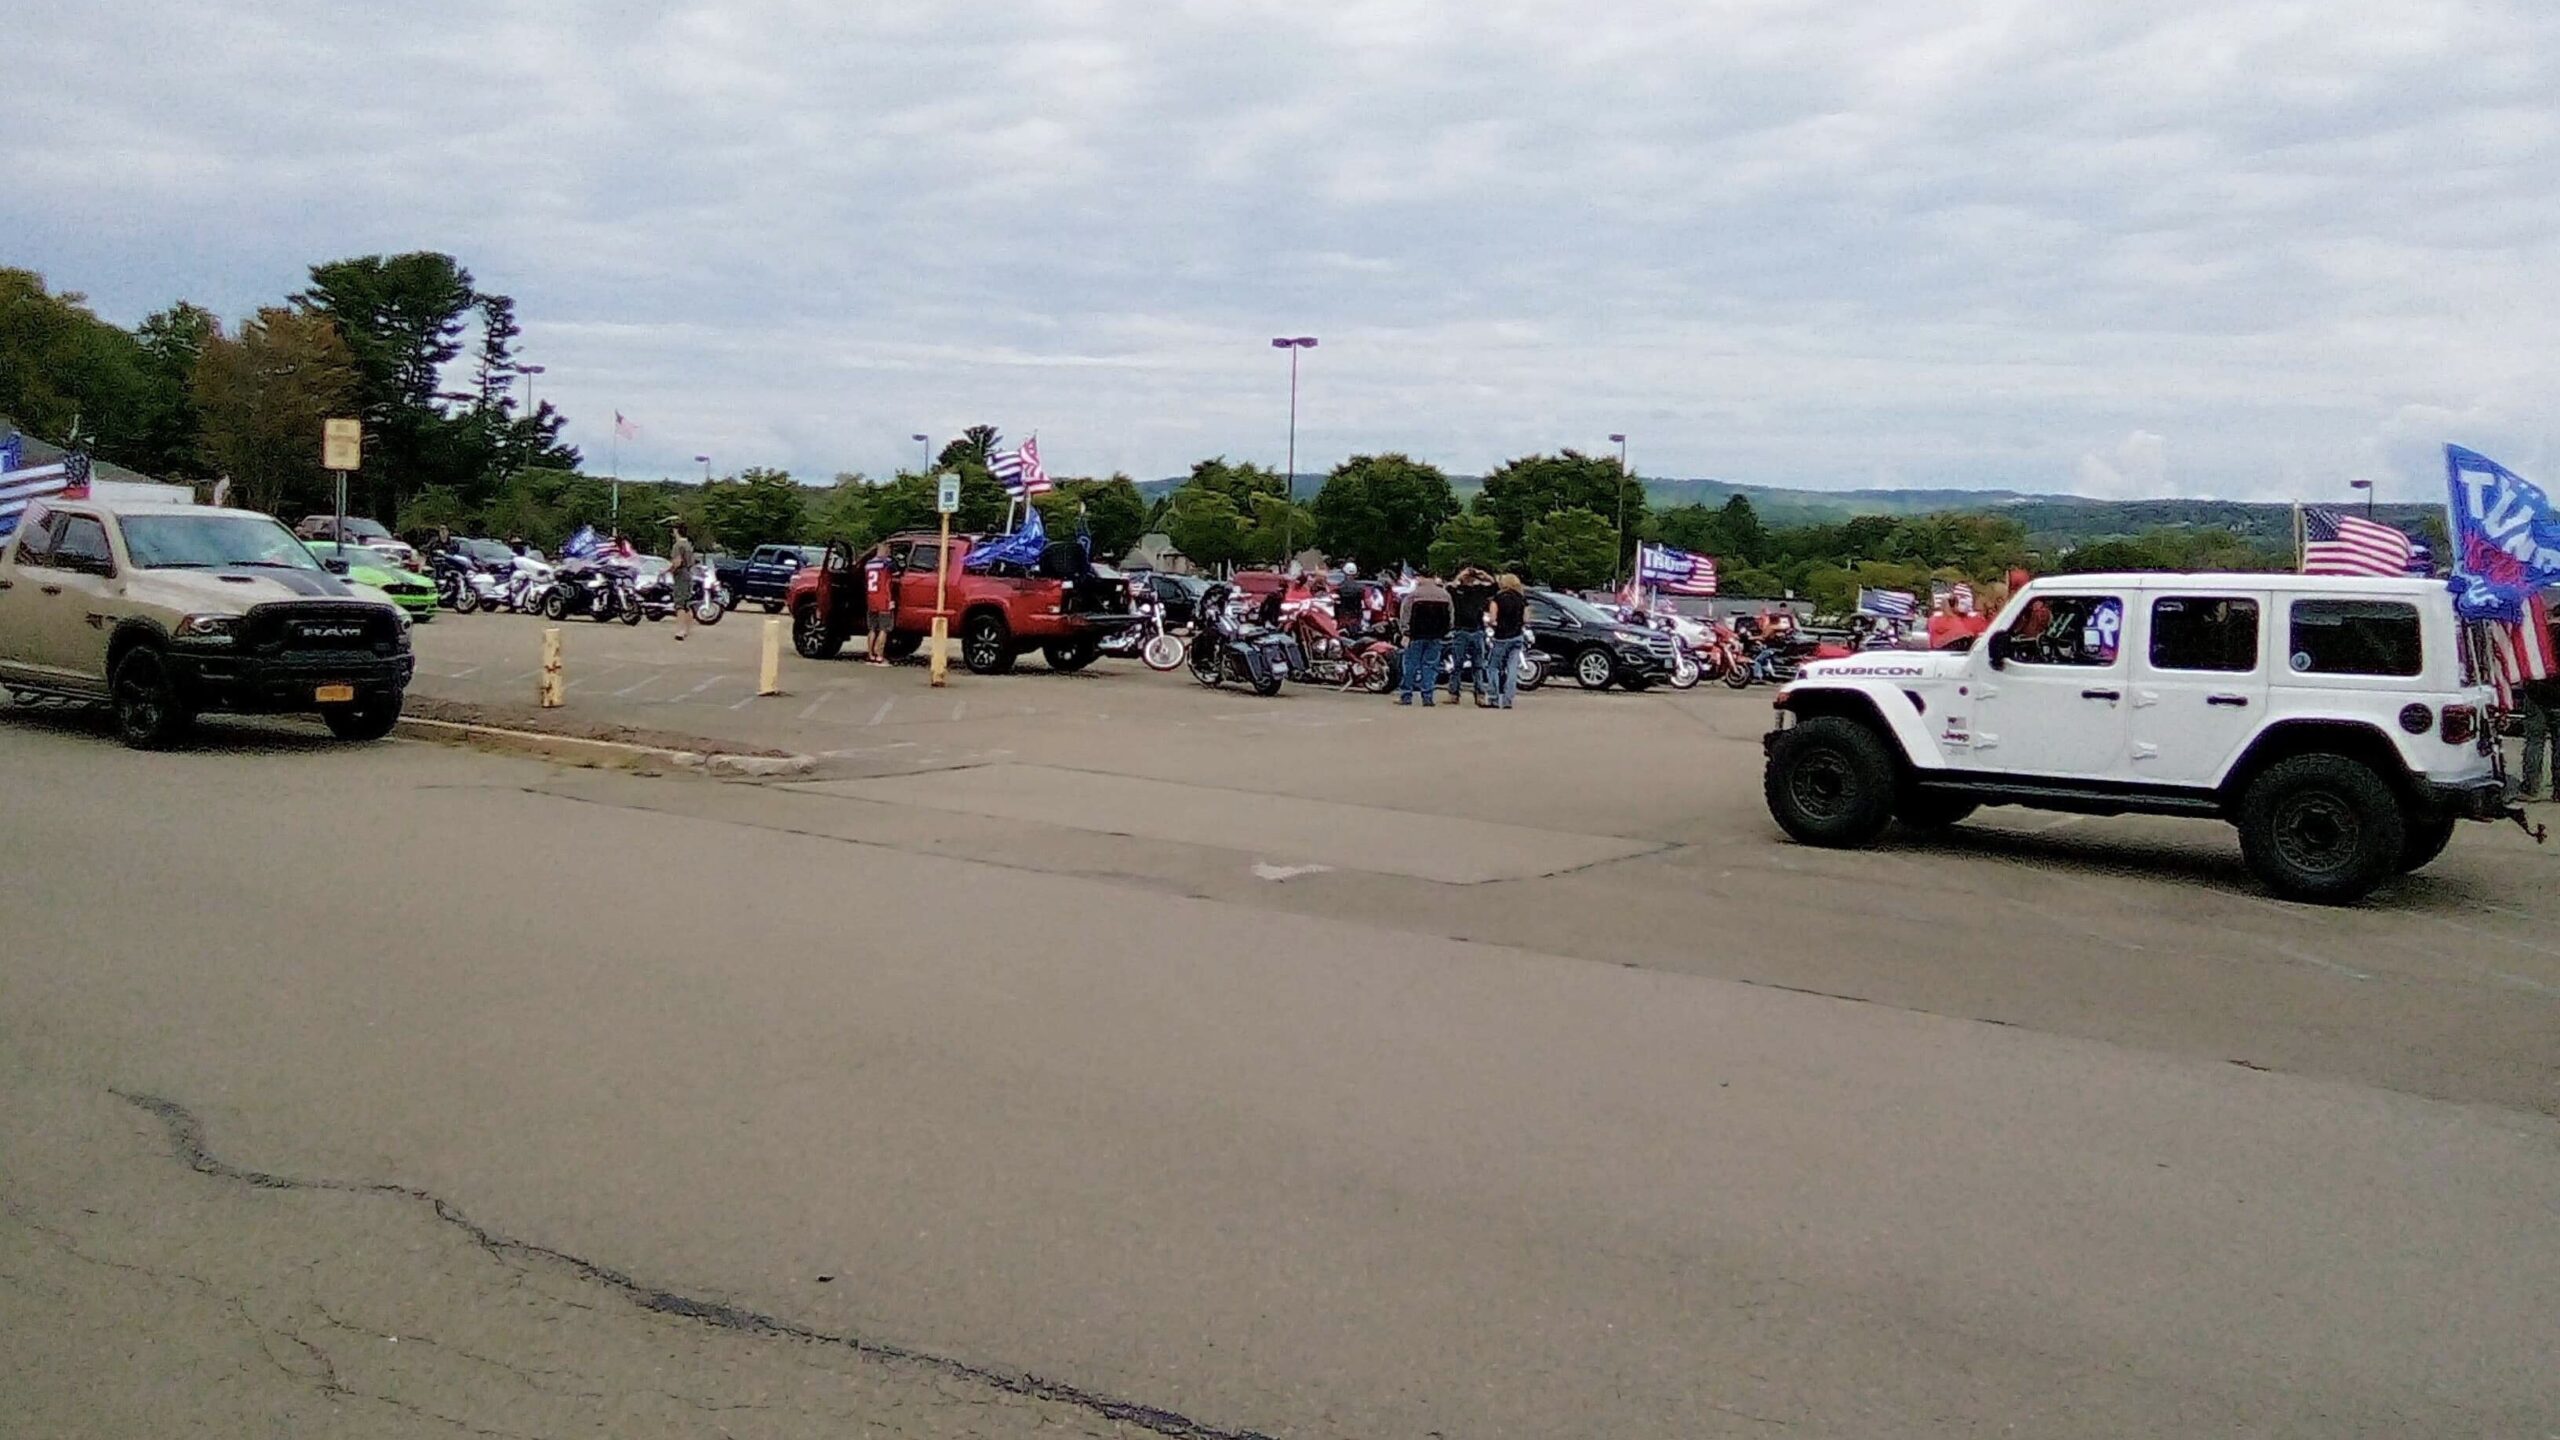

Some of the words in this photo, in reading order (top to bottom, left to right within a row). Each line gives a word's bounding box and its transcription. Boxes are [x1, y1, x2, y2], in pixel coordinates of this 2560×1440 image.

[868, 570, 878, 592] 2
[303, 627, 361, 637] RAM
[1818, 667, 1923, 676] RUBICON
[1941, 730, 1970, 741] Jeep
